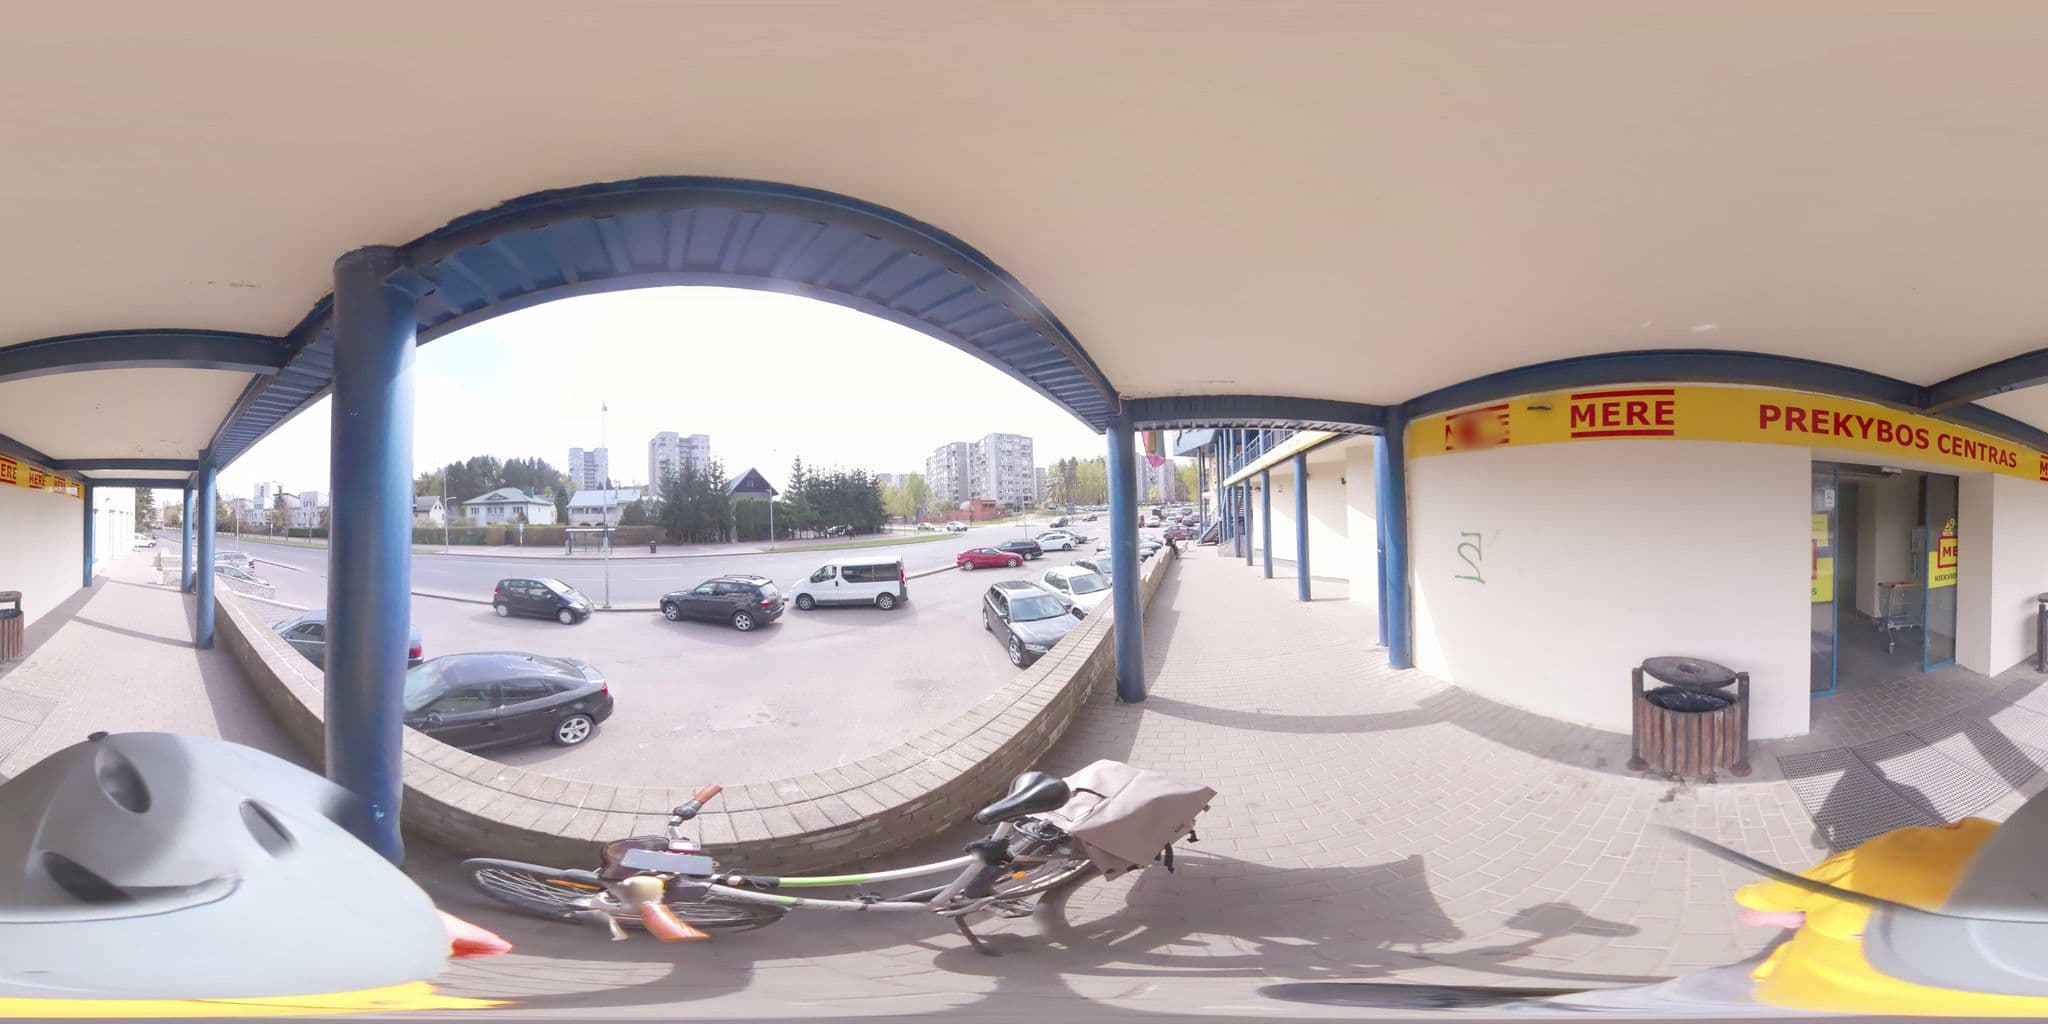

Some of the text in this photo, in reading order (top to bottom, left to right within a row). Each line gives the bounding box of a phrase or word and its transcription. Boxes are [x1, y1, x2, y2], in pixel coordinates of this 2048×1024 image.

[1570, 400, 1675, 428] MERE
[1759, 404, 2017, 468] PREKYBOS CENTRAS
